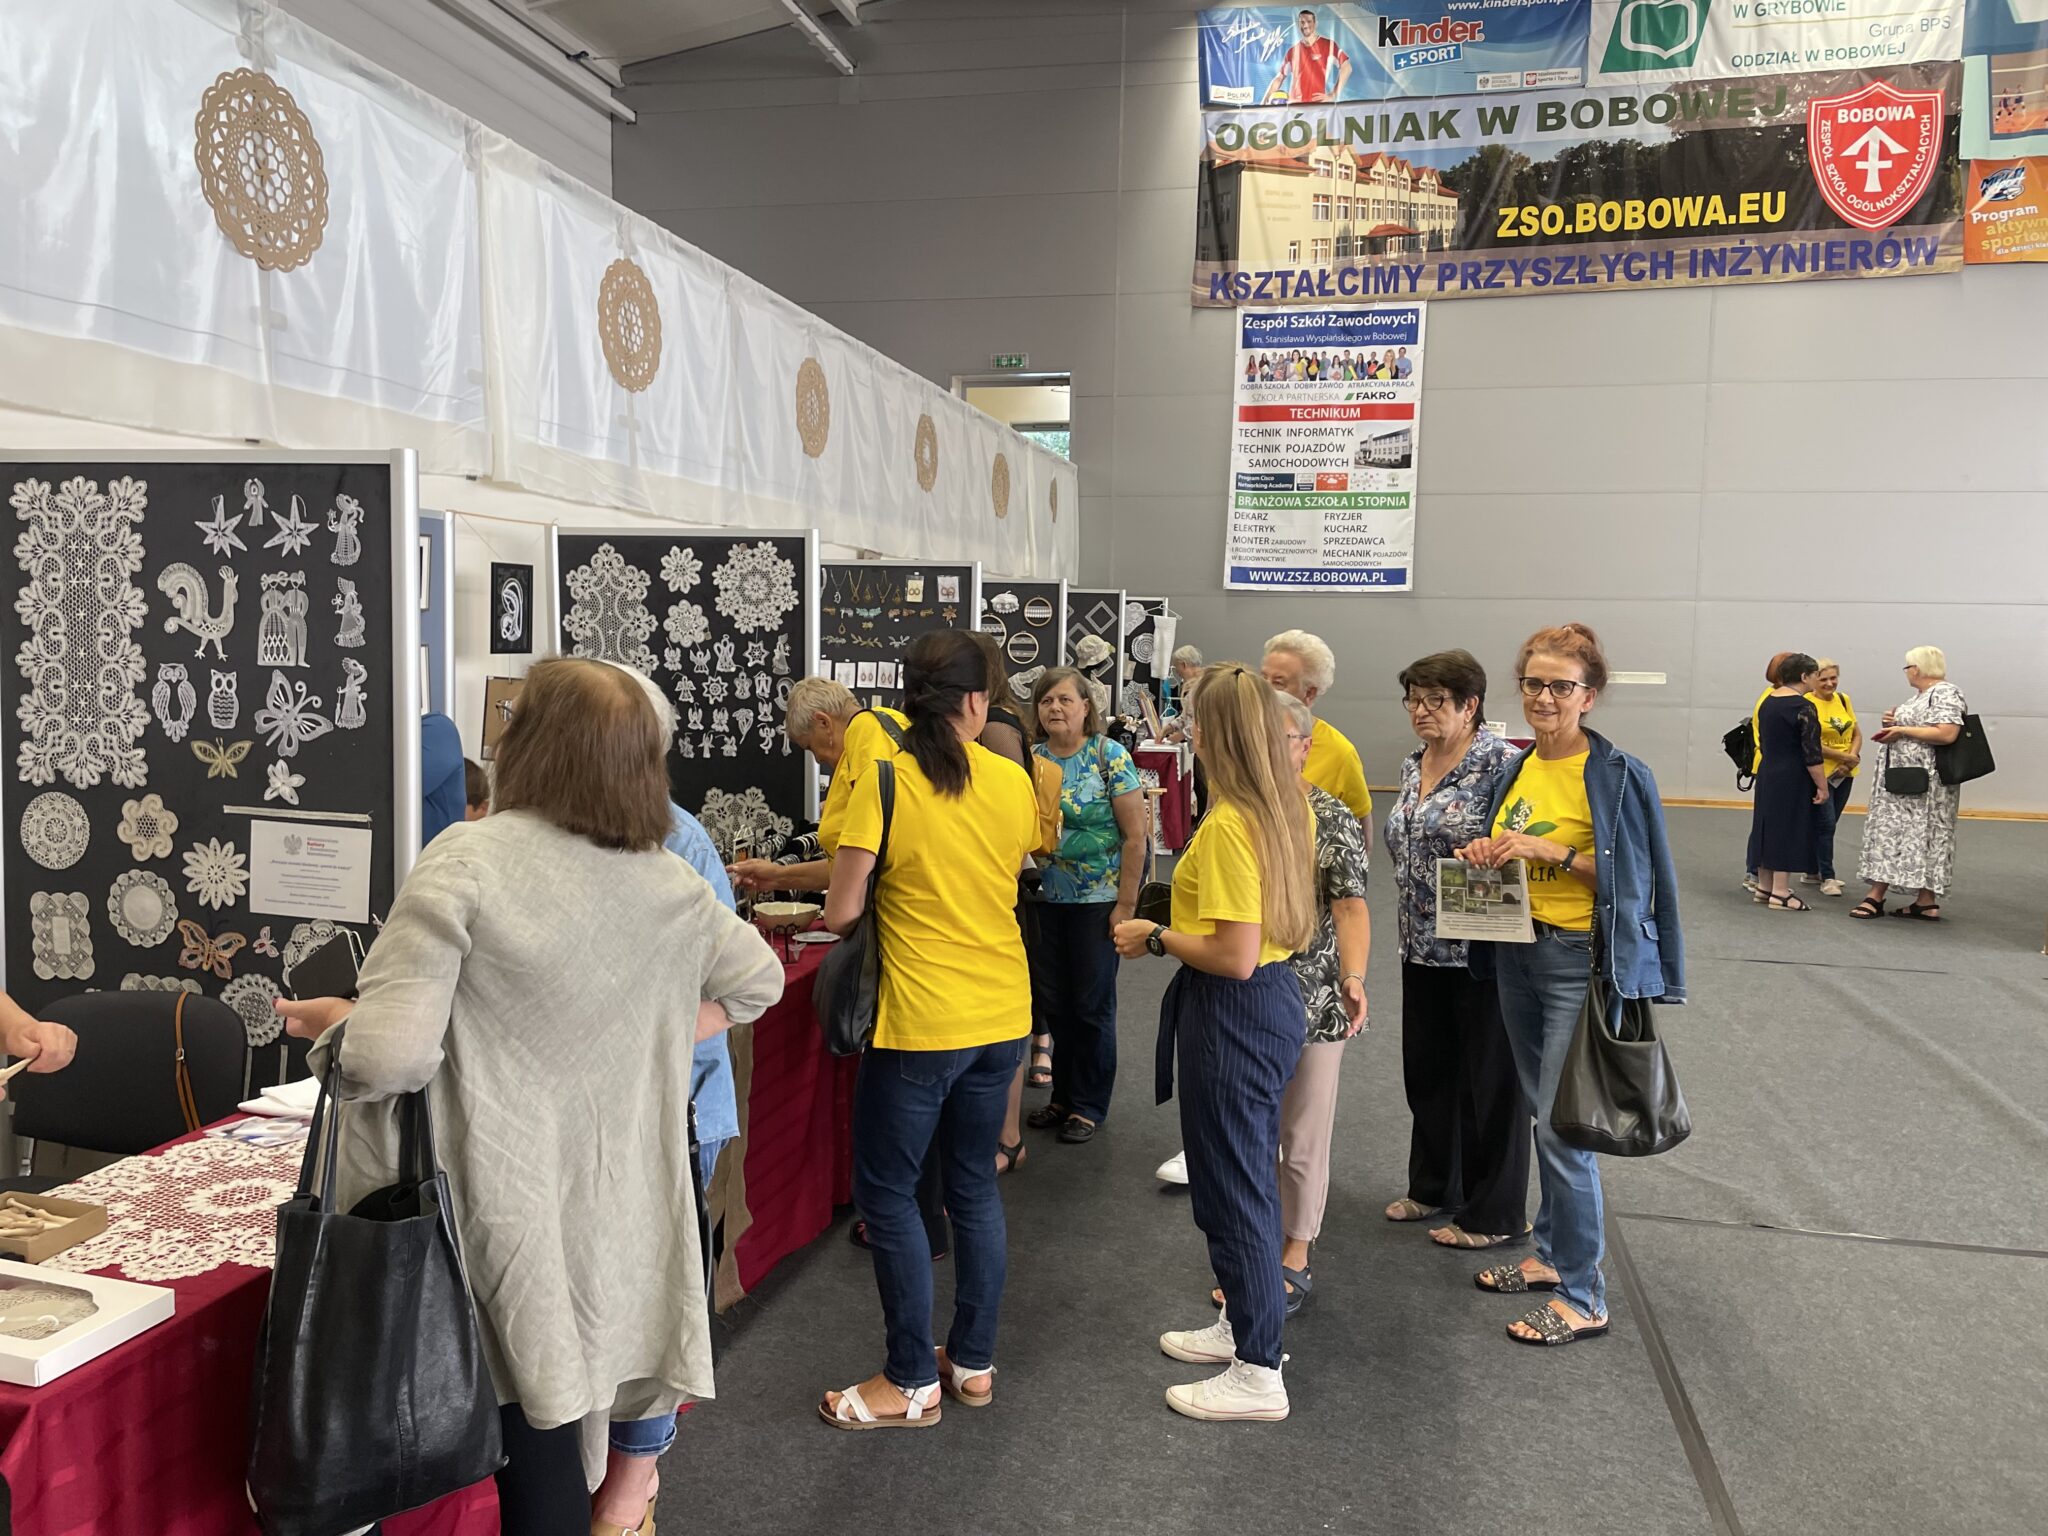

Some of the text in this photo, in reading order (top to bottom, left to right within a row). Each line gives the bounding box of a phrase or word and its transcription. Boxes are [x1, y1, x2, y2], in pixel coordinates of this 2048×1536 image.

[1733, 0, 1846, 18] W GRYBOWIE
[1869, 16, 1951, 38] Grupa BPS
[1410, 46, 1456, 65] SPORT
[1731, 42, 1906, 68] ODDZIAŁ W BOBOWEJ
[1215, 85, 1788, 151] OGÓLNIAK W BOBOWEJ
[1837, 105, 1916, 123] BOBOWA
[1821, 119, 1834, 162] ZESPÓŁ
[1846, 114, 1931, 212] OGÓLNOKSZTAŁCĄCYCH
[1825, 163, 1849, 197] SZKÓŁ
[1497, 191, 1786, 238] ZSO.BOBOWA.EU
[1971, 205, 2039, 224] Program
[1210, 231, 1939, 300] KSZTAŁCIMY PRZYSZŁYCH INŻYNIERÓW
[1244, 312, 1416, 332] Zespół Szkół Zawodowych
[1265, 335, 1305, 343] Stanisława
[1306, 334, 1363, 346] Wyspiańskiego
[1373, 331, 1407, 342] Bobowej
[1264, 382, 1291, 390] SZKOŁA
[1294, 382, 1317, 390] DOBRY
[1318, 381, 1344, 389] ZAWÓD
[1348, 380, 1391, 389] ATRAKCYJNA
[1391, 380, 1415, 388] PRACA
[1251, 391, 1396, 402] SZKOŁA PARTNERSKA FAKRO
[1289, 407, 1361, 419] TECHNIKUM
[1238, 427, 1354, 438] TECHNIK INFORMATYK
[1238, 442, 1346, 454] TECHNIK POJAZDÓW
[1248, 458, 1349, 468] SAMOCHODOWYCH
[1237, 474, 1260, 482] Program
[1268, 482, 1293, 490] Academy
[1237, 495, 1301, 507] BRANŻOWA
[1304, 496, 1348, 507] SZKOŁA
[1357, 496, 1407, 507] STOPNIA
[1234, 512, 1269, 520] DEKARZ
[1324, 512, 1363, 521] FRYZJER
[1233, 524, 1276, 533] ELEKTRYK
[1324, 524, 1368, 533] KUCHARZ
[1232, 536, 1270, 545] MONTER
[1323, 537, 1385, 545] SPRZEDAWCA
[1255, 547, 1318, 555] WYKOŃCZENIOWYCH
[1322, 549, 1408, 558] MECHANIK POJAZDÓW
[1249, 570, 1387, 583] WWW.ZSZ.BOBOWA.PL
